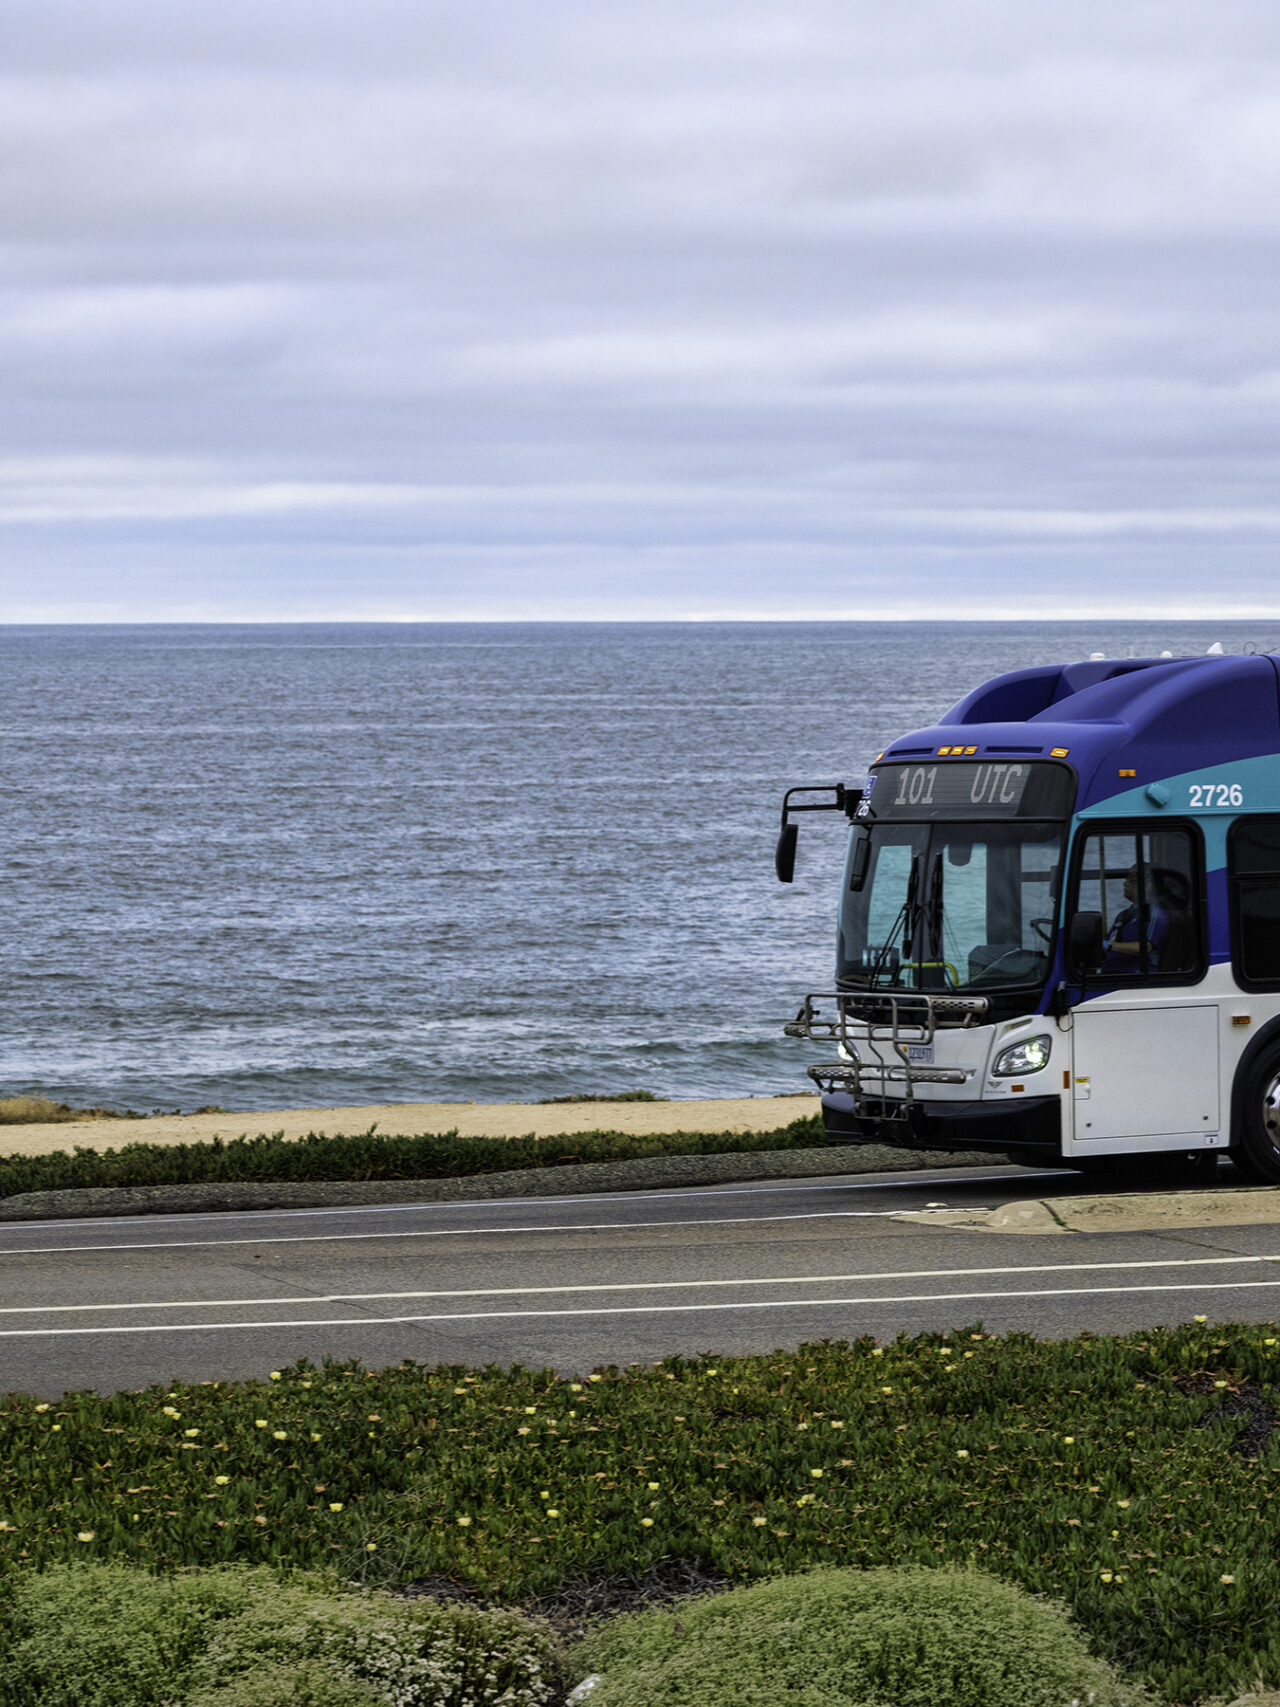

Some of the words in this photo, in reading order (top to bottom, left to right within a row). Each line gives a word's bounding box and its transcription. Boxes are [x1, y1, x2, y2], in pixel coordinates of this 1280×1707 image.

[894, 766, 938, 805] 101
[970, 764, 1022, 804] UTC
[1188, 784, 1243, 807] 2726
